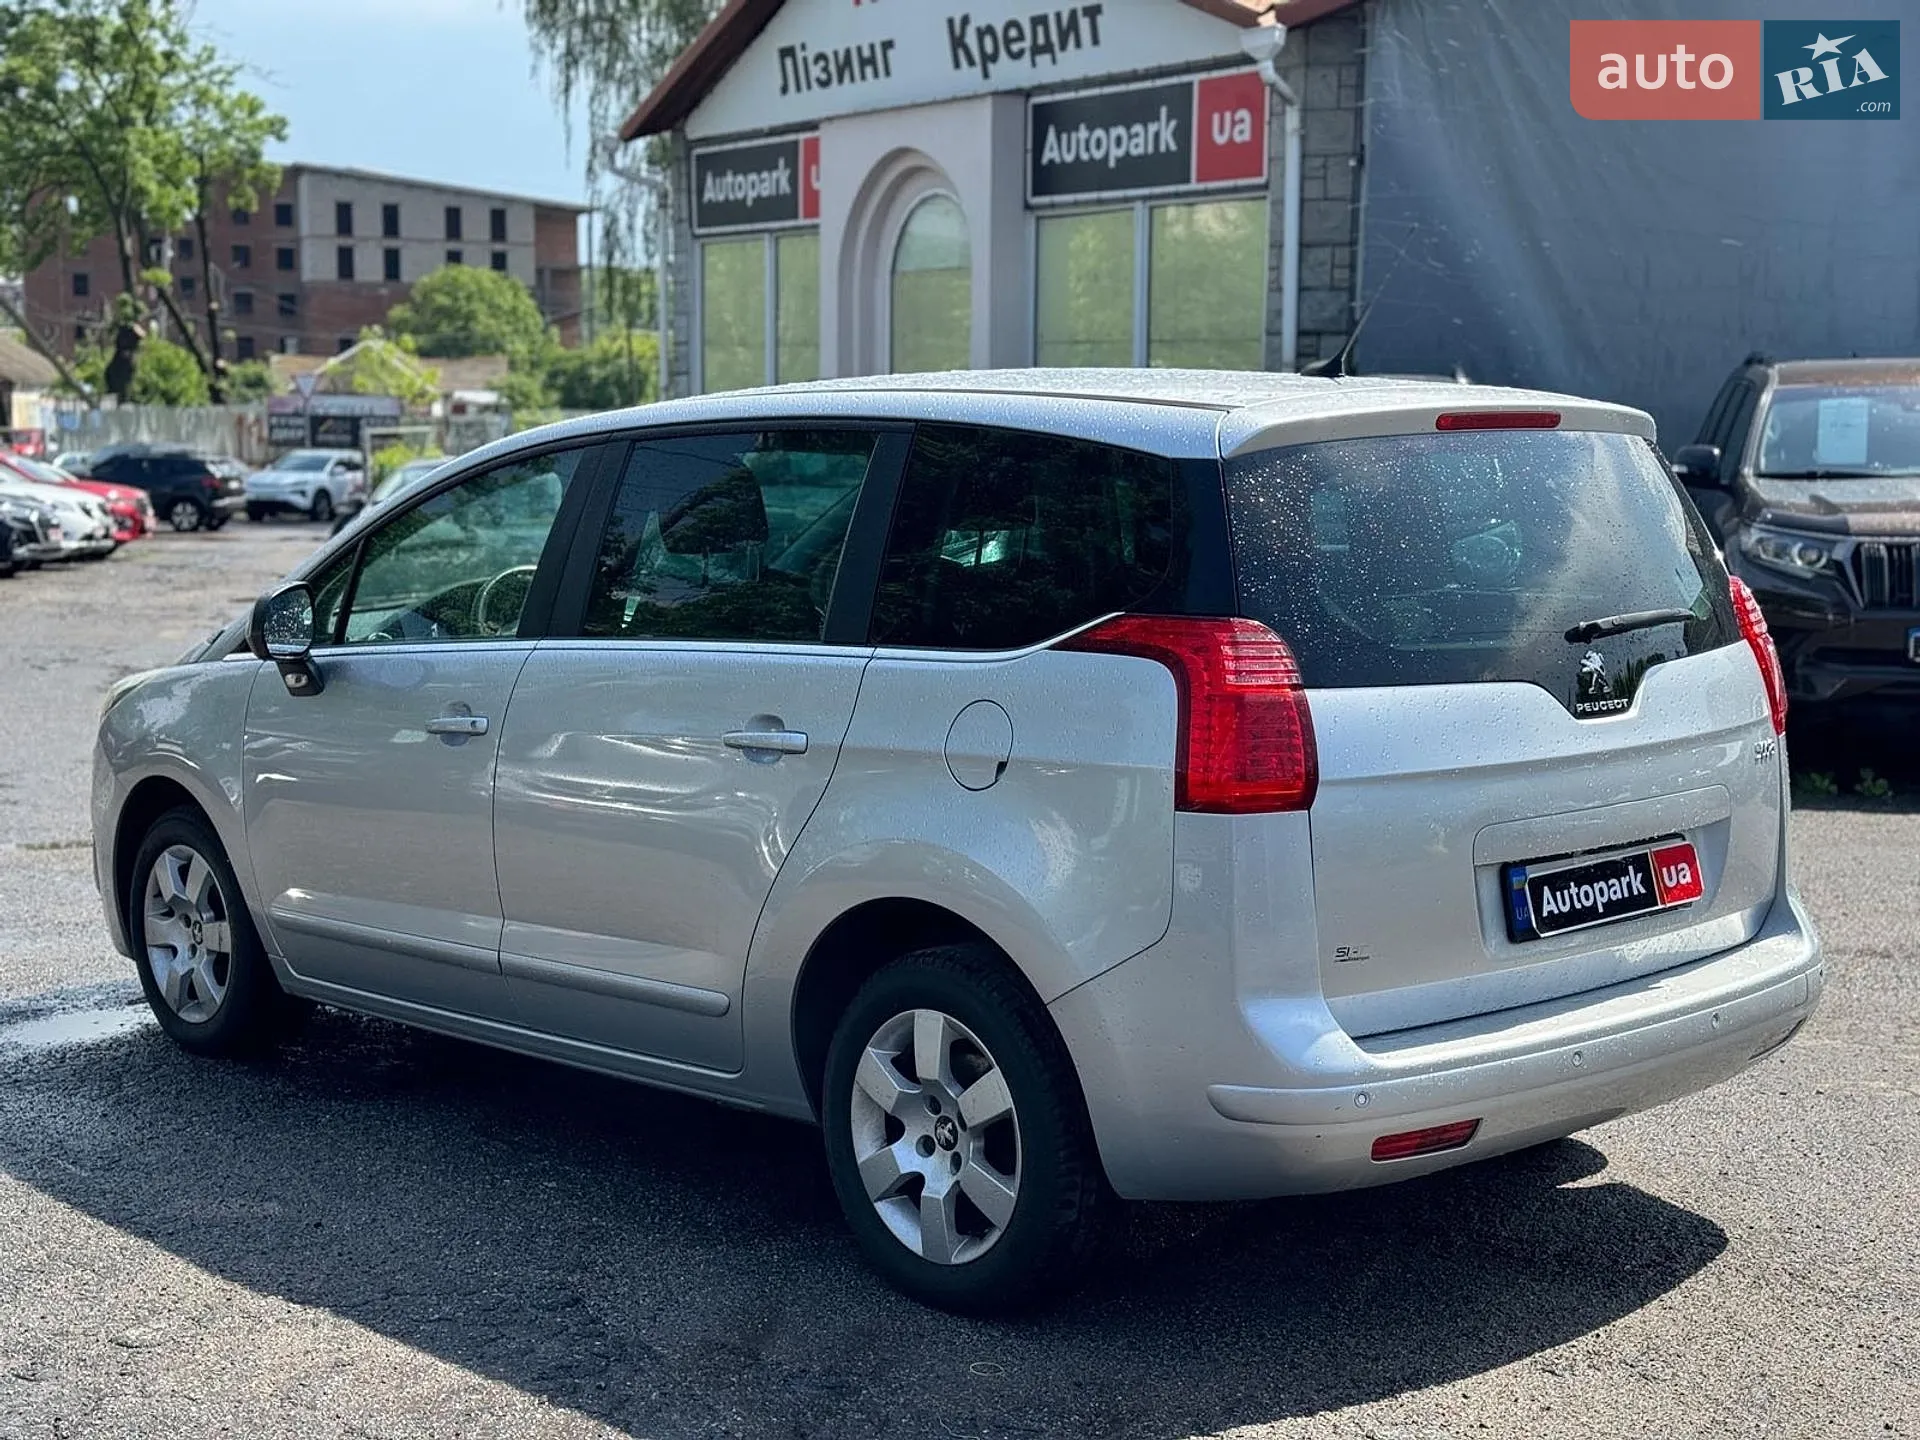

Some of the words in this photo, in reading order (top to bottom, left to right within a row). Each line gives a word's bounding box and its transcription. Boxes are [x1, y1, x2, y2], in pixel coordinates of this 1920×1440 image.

[777, 39, 896, 96] Лізинг
[946, 4, 1104, 80] Кредит
[1041, 105, 1178, 169] Autopark
[1211, 107, 1253, 146] ua
[703, 156, 792, 208] Autopark
[811, 163, 821, 192] u
[1575, 698, 1629, 713] PEUGEOT
[1542, 865, 1647, 917] Autopark
[1662, 862, 1692, 889] ua
